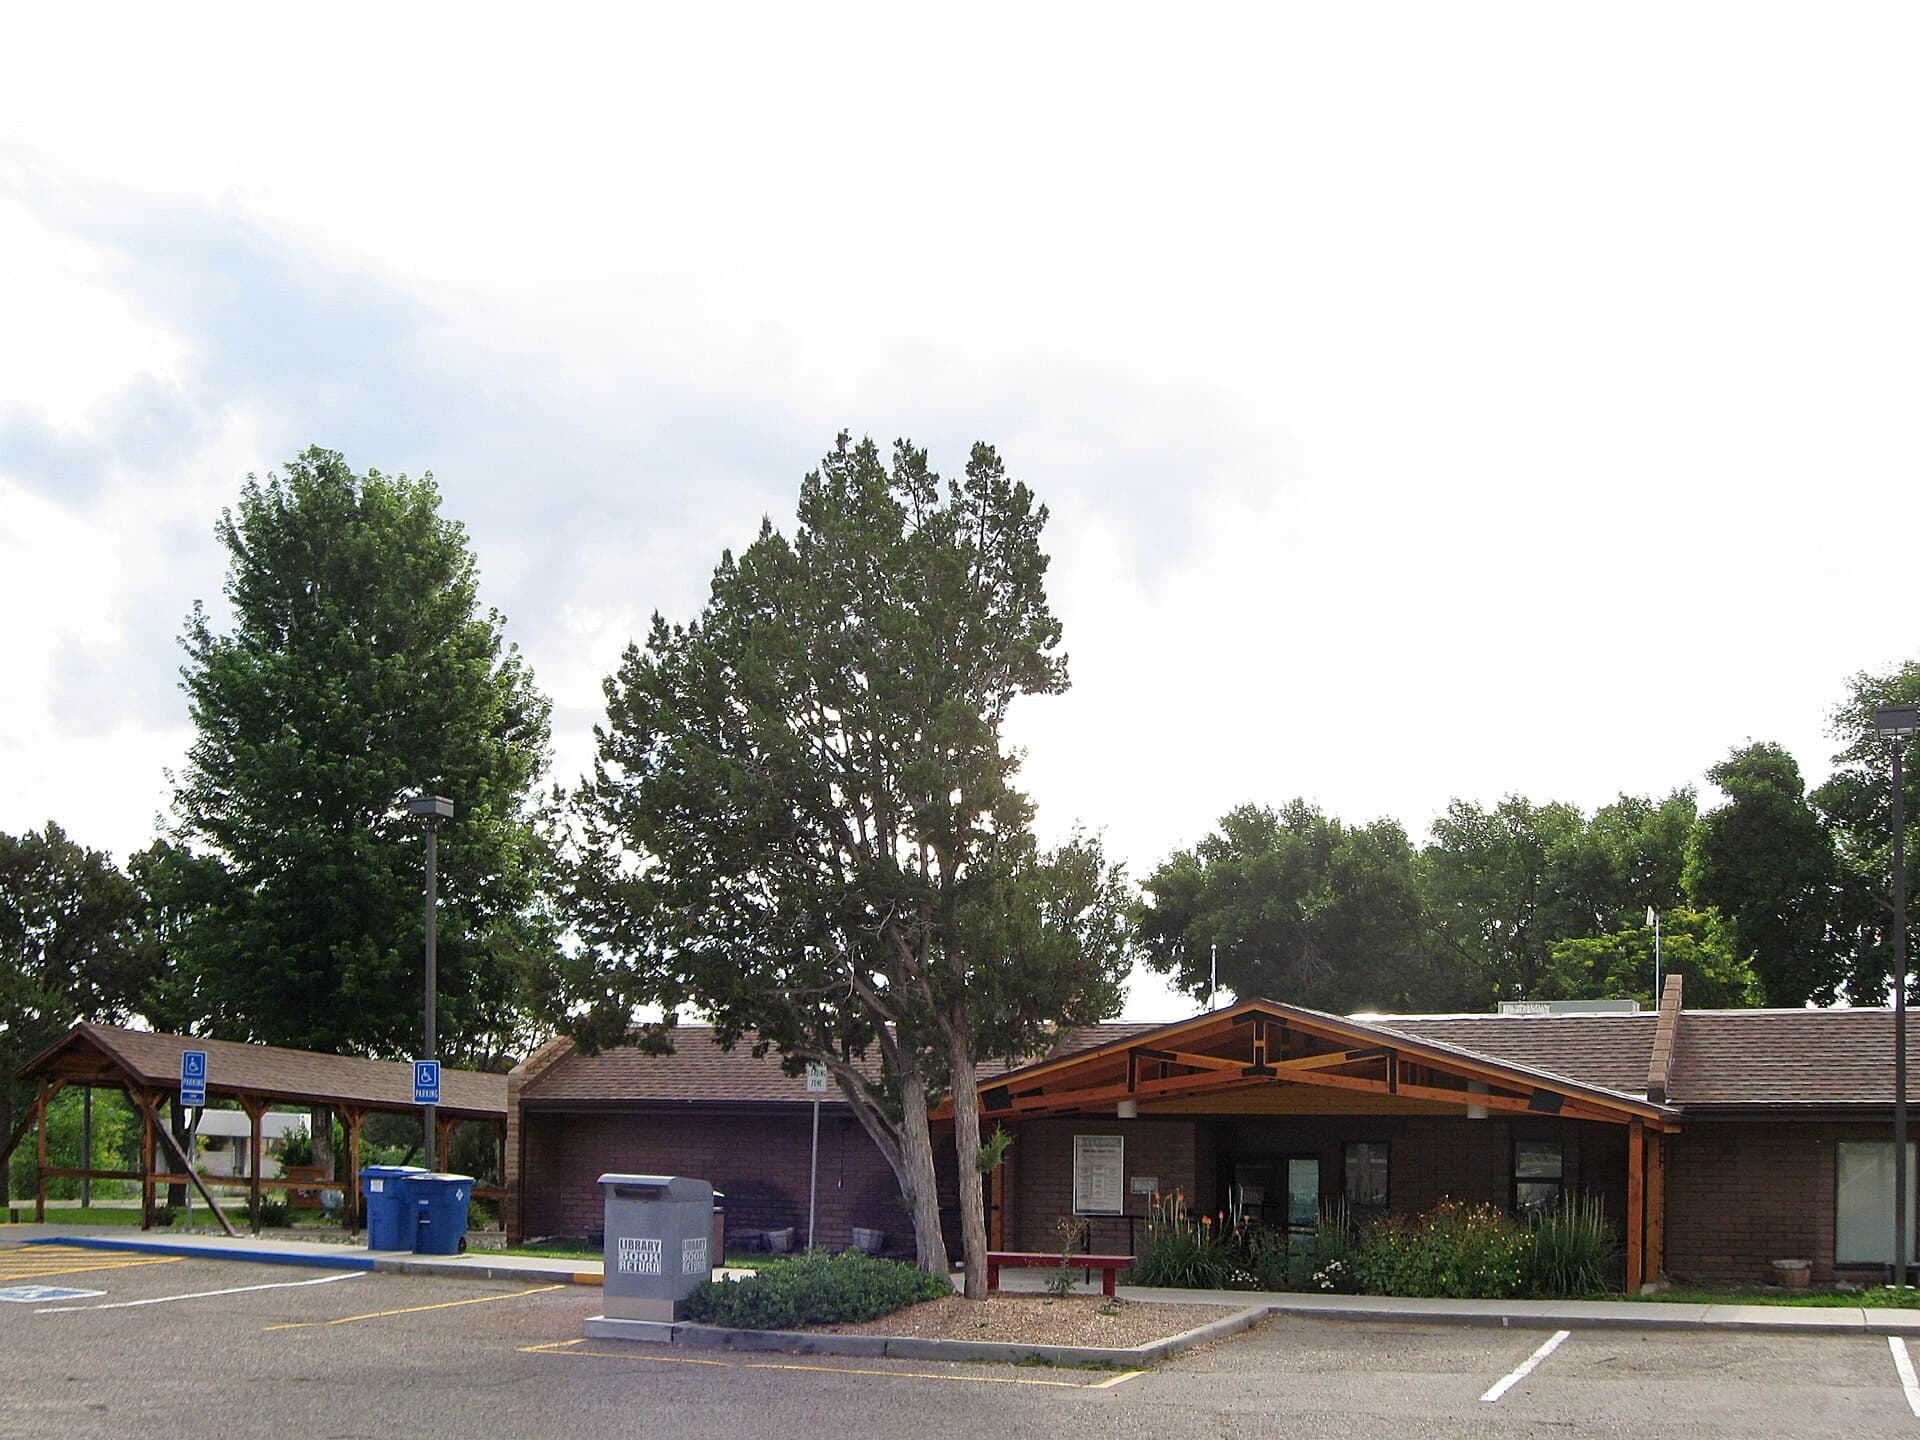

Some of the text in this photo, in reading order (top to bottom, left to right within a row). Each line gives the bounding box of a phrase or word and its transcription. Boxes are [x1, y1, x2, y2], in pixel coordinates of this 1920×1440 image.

[415, 1089, 438, 1099] PARKING
[620, 1239, 660, 1252] LIBRARY
[620, 1251, 660, 1261] BOOK
[683, 1251, 706, 1261] BOOK
[620, 1260, 660, 1273] RETURN
